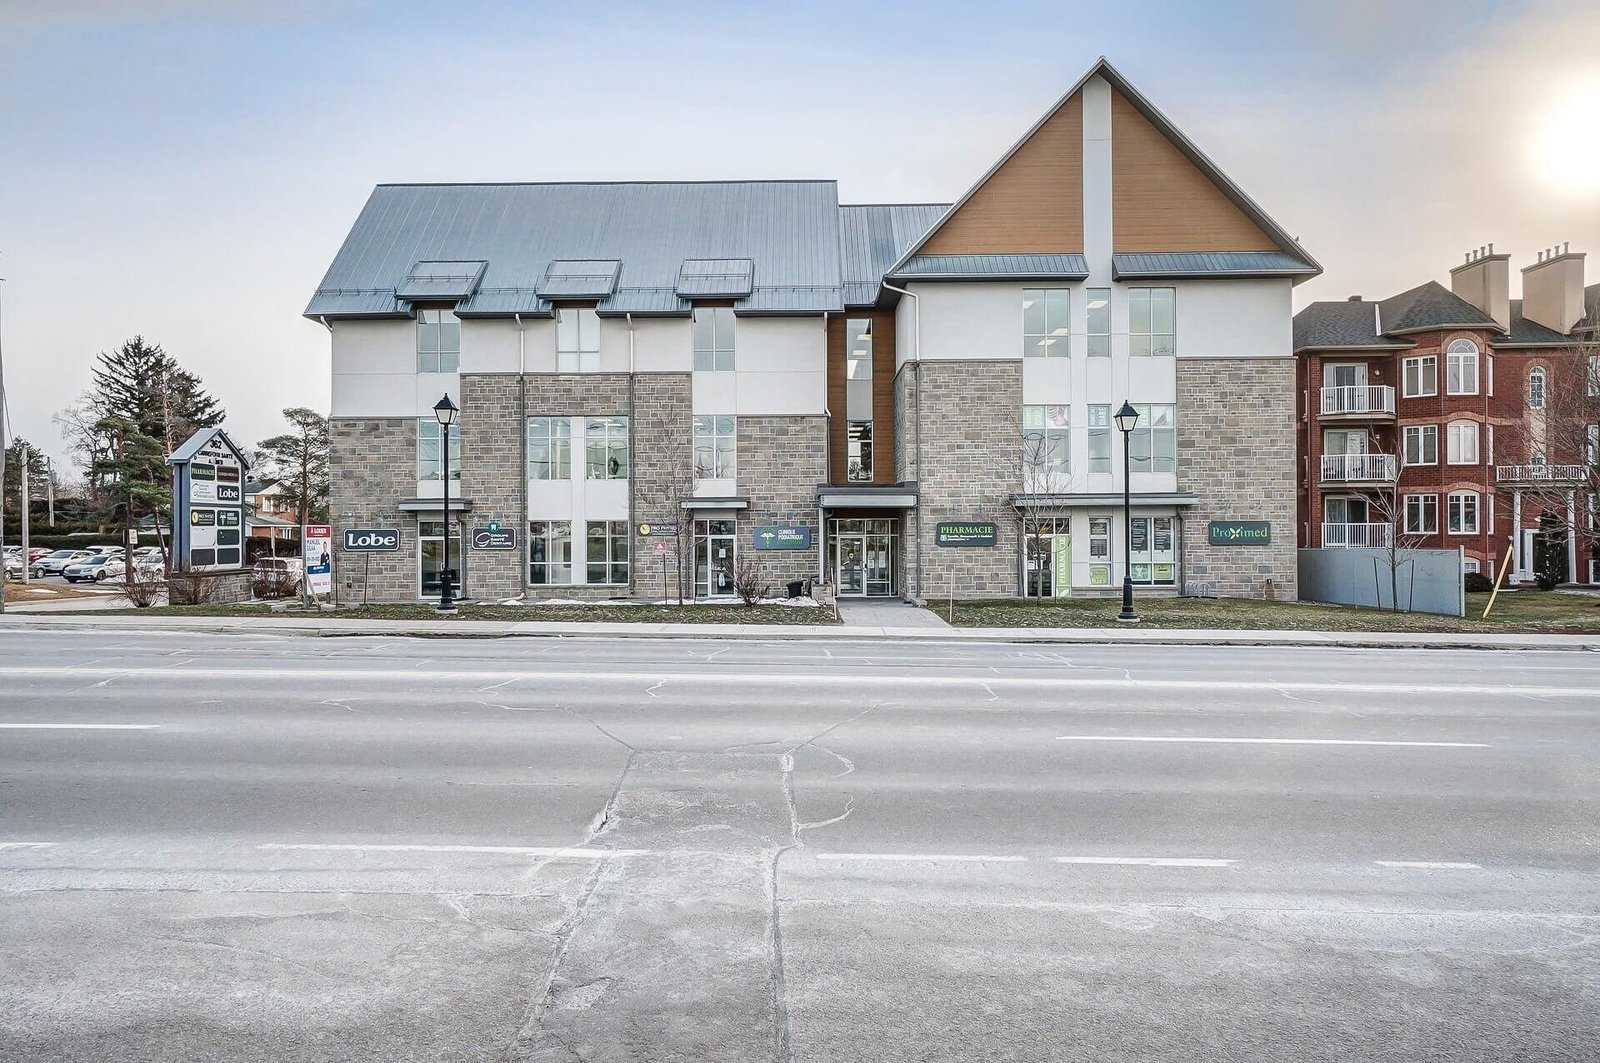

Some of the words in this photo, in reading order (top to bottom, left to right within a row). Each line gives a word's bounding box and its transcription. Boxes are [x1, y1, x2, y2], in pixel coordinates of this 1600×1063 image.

[209, 439, 222, 449] 362
[219, 487, 238, 498] Lobe
[941, 526, 993, 534] PHARMACIE
[1212, 526, 1268, 539] Proximed
[348, 533, 396, 546] Lobe
